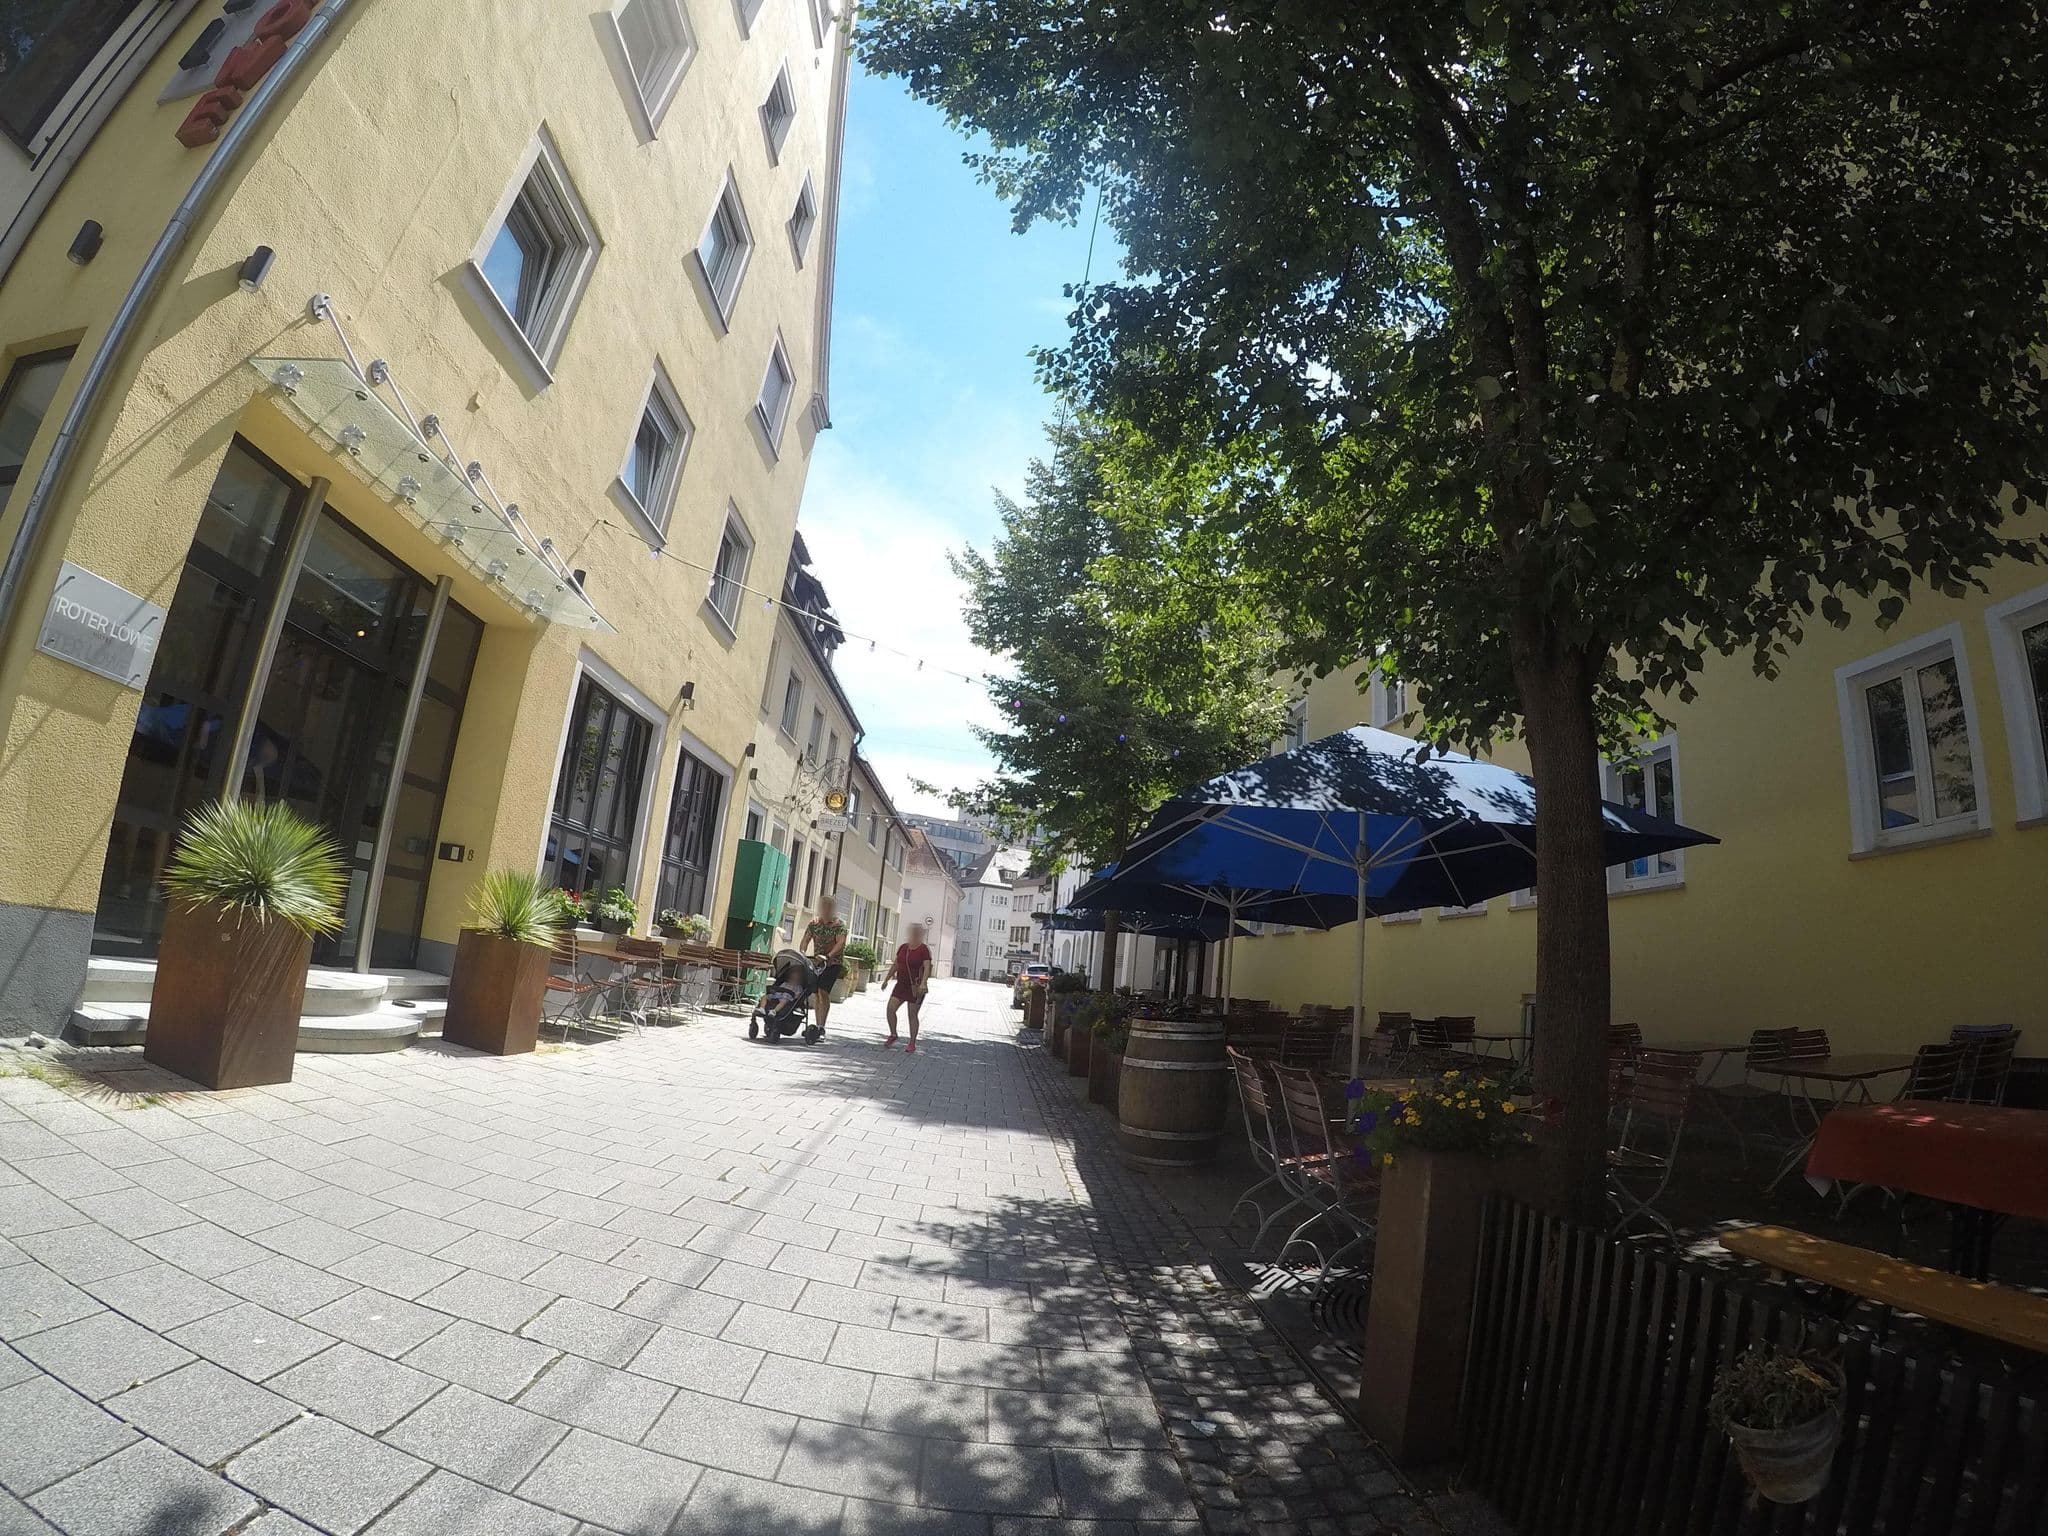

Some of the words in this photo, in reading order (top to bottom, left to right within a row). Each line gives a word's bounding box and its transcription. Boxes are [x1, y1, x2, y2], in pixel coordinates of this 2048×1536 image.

[56, 597, 109, 634] ROTER
[110, 621, 153, 653] LÖWE
[468, 850, 475, 862] 8
